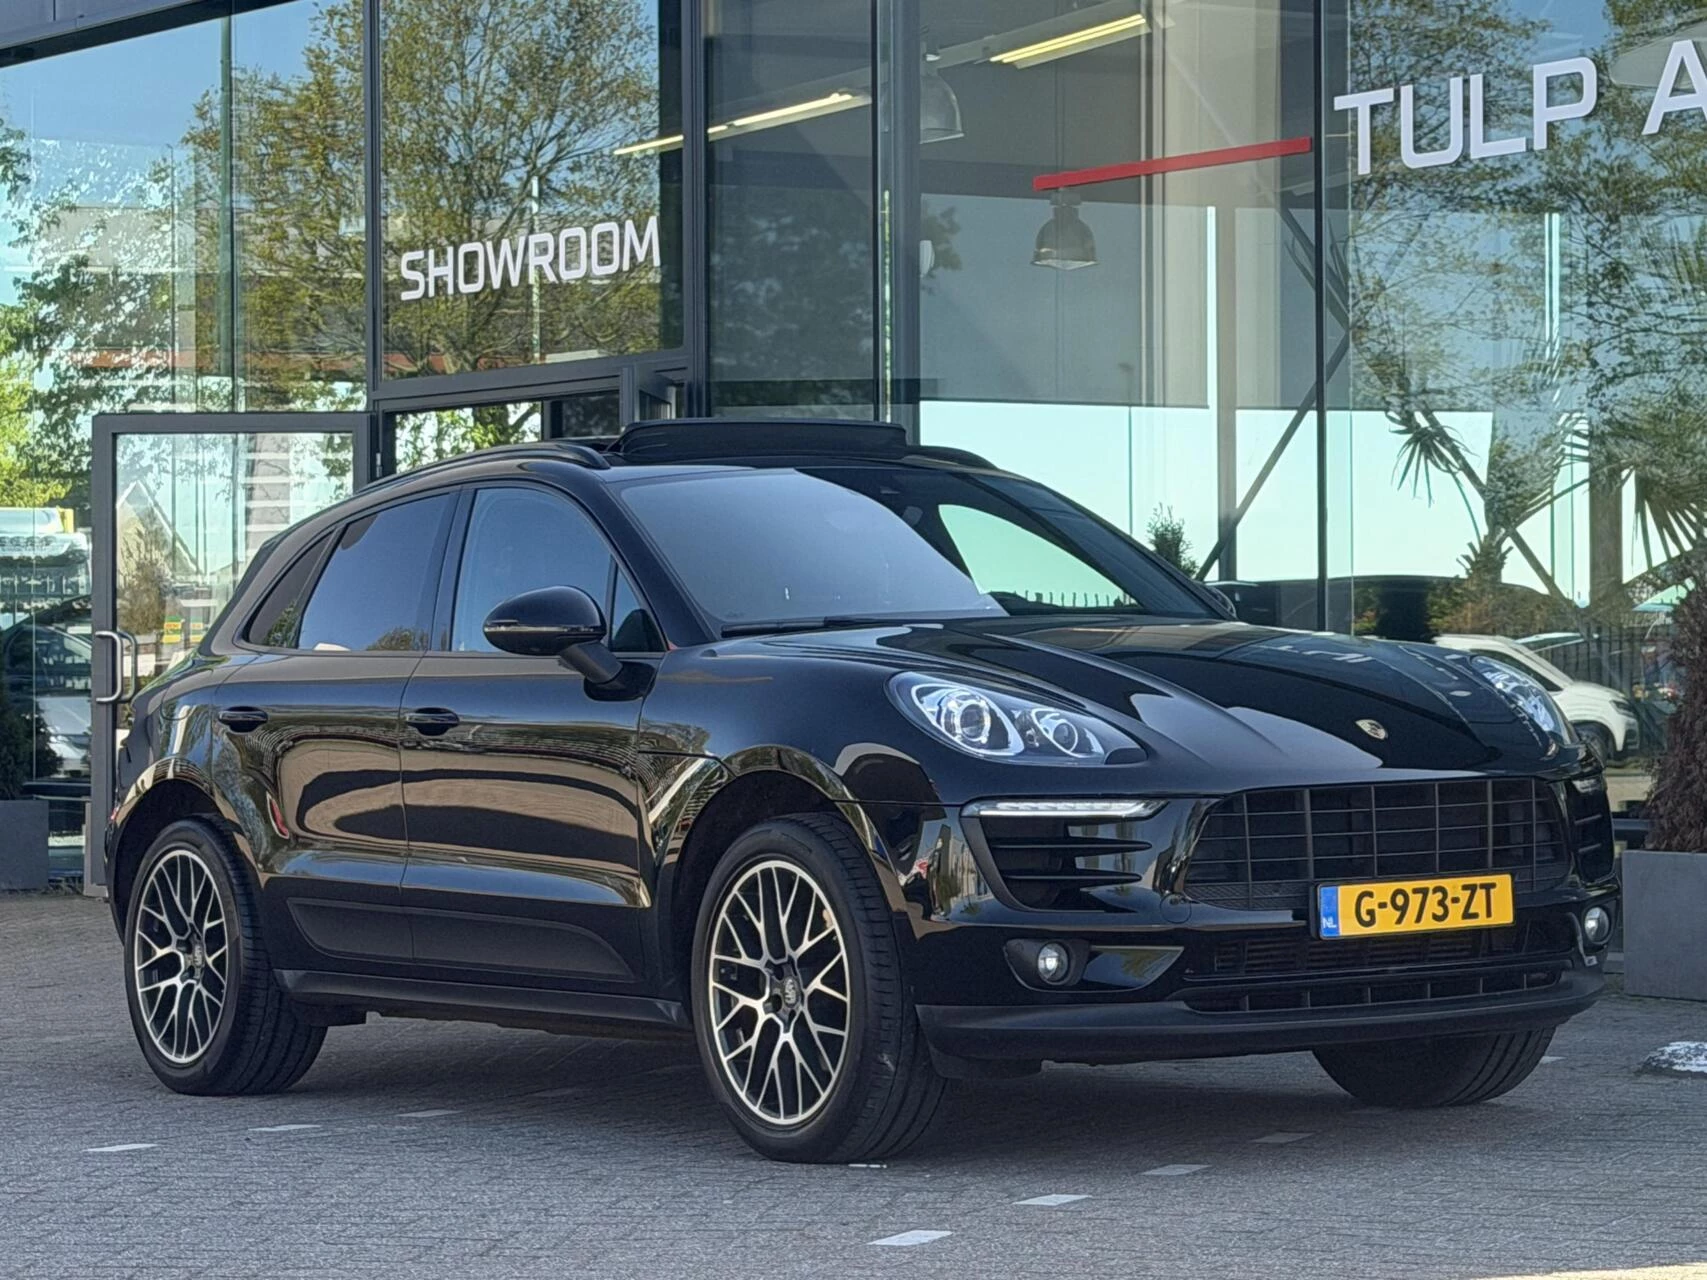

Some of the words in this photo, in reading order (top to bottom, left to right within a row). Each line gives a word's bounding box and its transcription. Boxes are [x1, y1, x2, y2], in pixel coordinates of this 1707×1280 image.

[1334, 57, 1598, 176] TULP
[401, 215, 661, 300] SHOWROOM
[1322, 916, 1337, 929] NL
[1355, 882, 1497, 928] G-973-ZT
